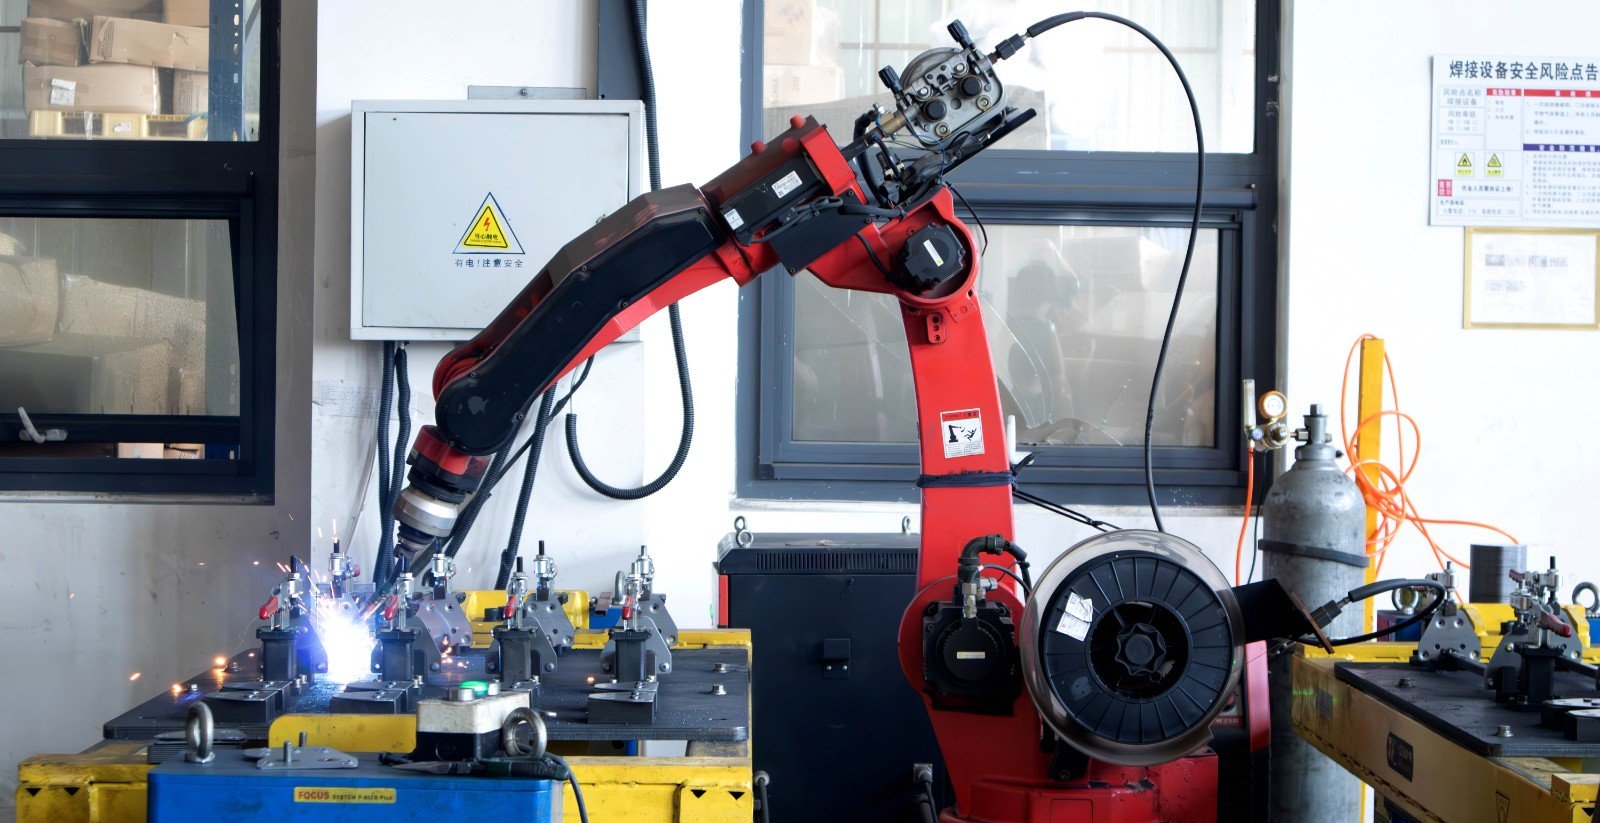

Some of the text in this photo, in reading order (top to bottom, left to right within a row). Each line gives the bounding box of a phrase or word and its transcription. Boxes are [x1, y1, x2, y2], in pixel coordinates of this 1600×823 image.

[1449, 60, 1599, 81] 焊接设备安全风险点告
[297, 791, 330, 800] FOCUS
